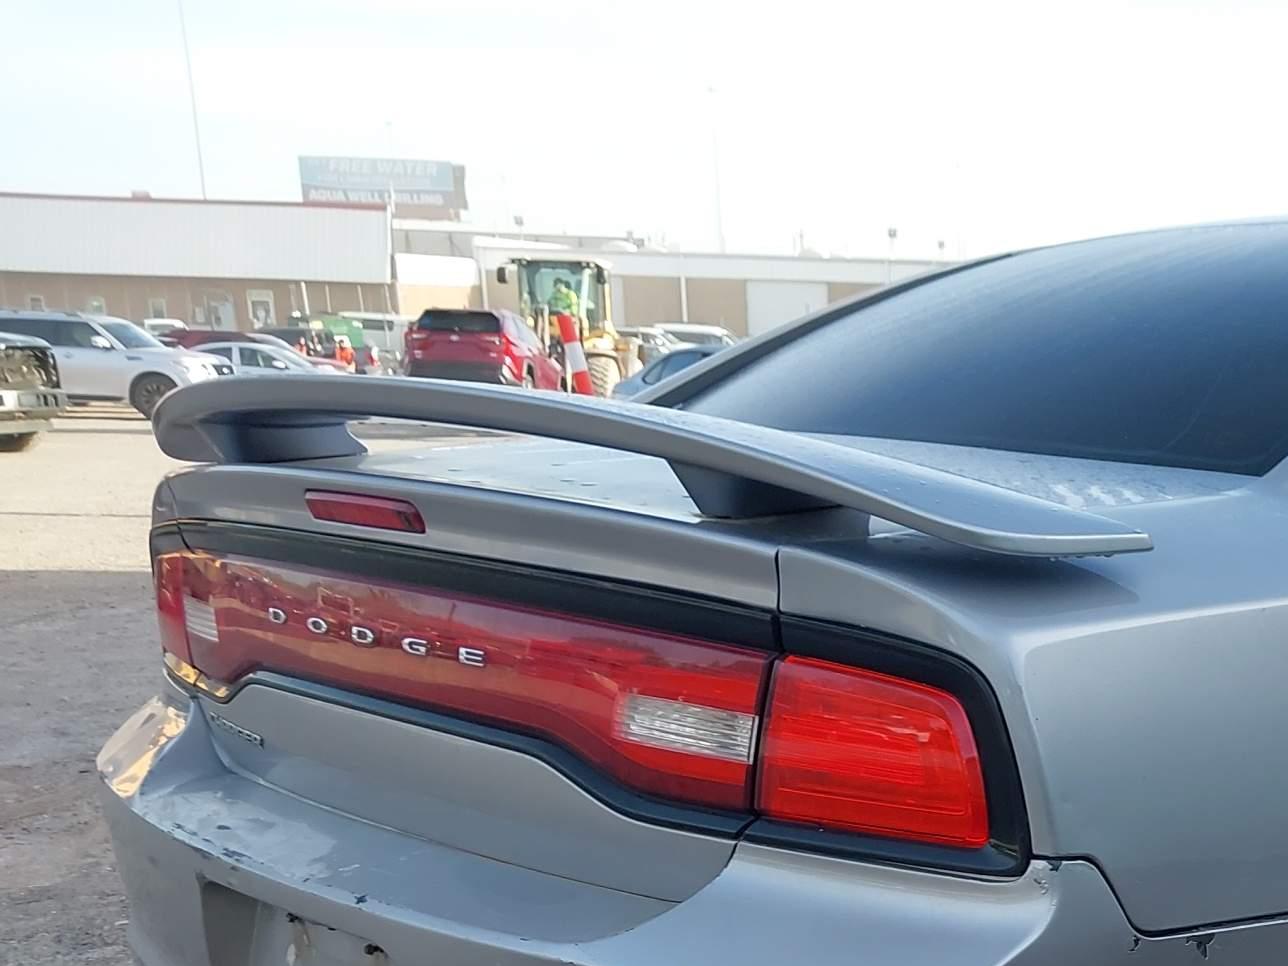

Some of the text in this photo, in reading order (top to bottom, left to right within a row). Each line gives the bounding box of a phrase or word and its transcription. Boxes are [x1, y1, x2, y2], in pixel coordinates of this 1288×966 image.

[328, 159, 370, 175] FREE
[376, 160, 438, 177] WATER
[308, 189, 348, 203] AQUA
[267, 607, 487, 668] DODGE
